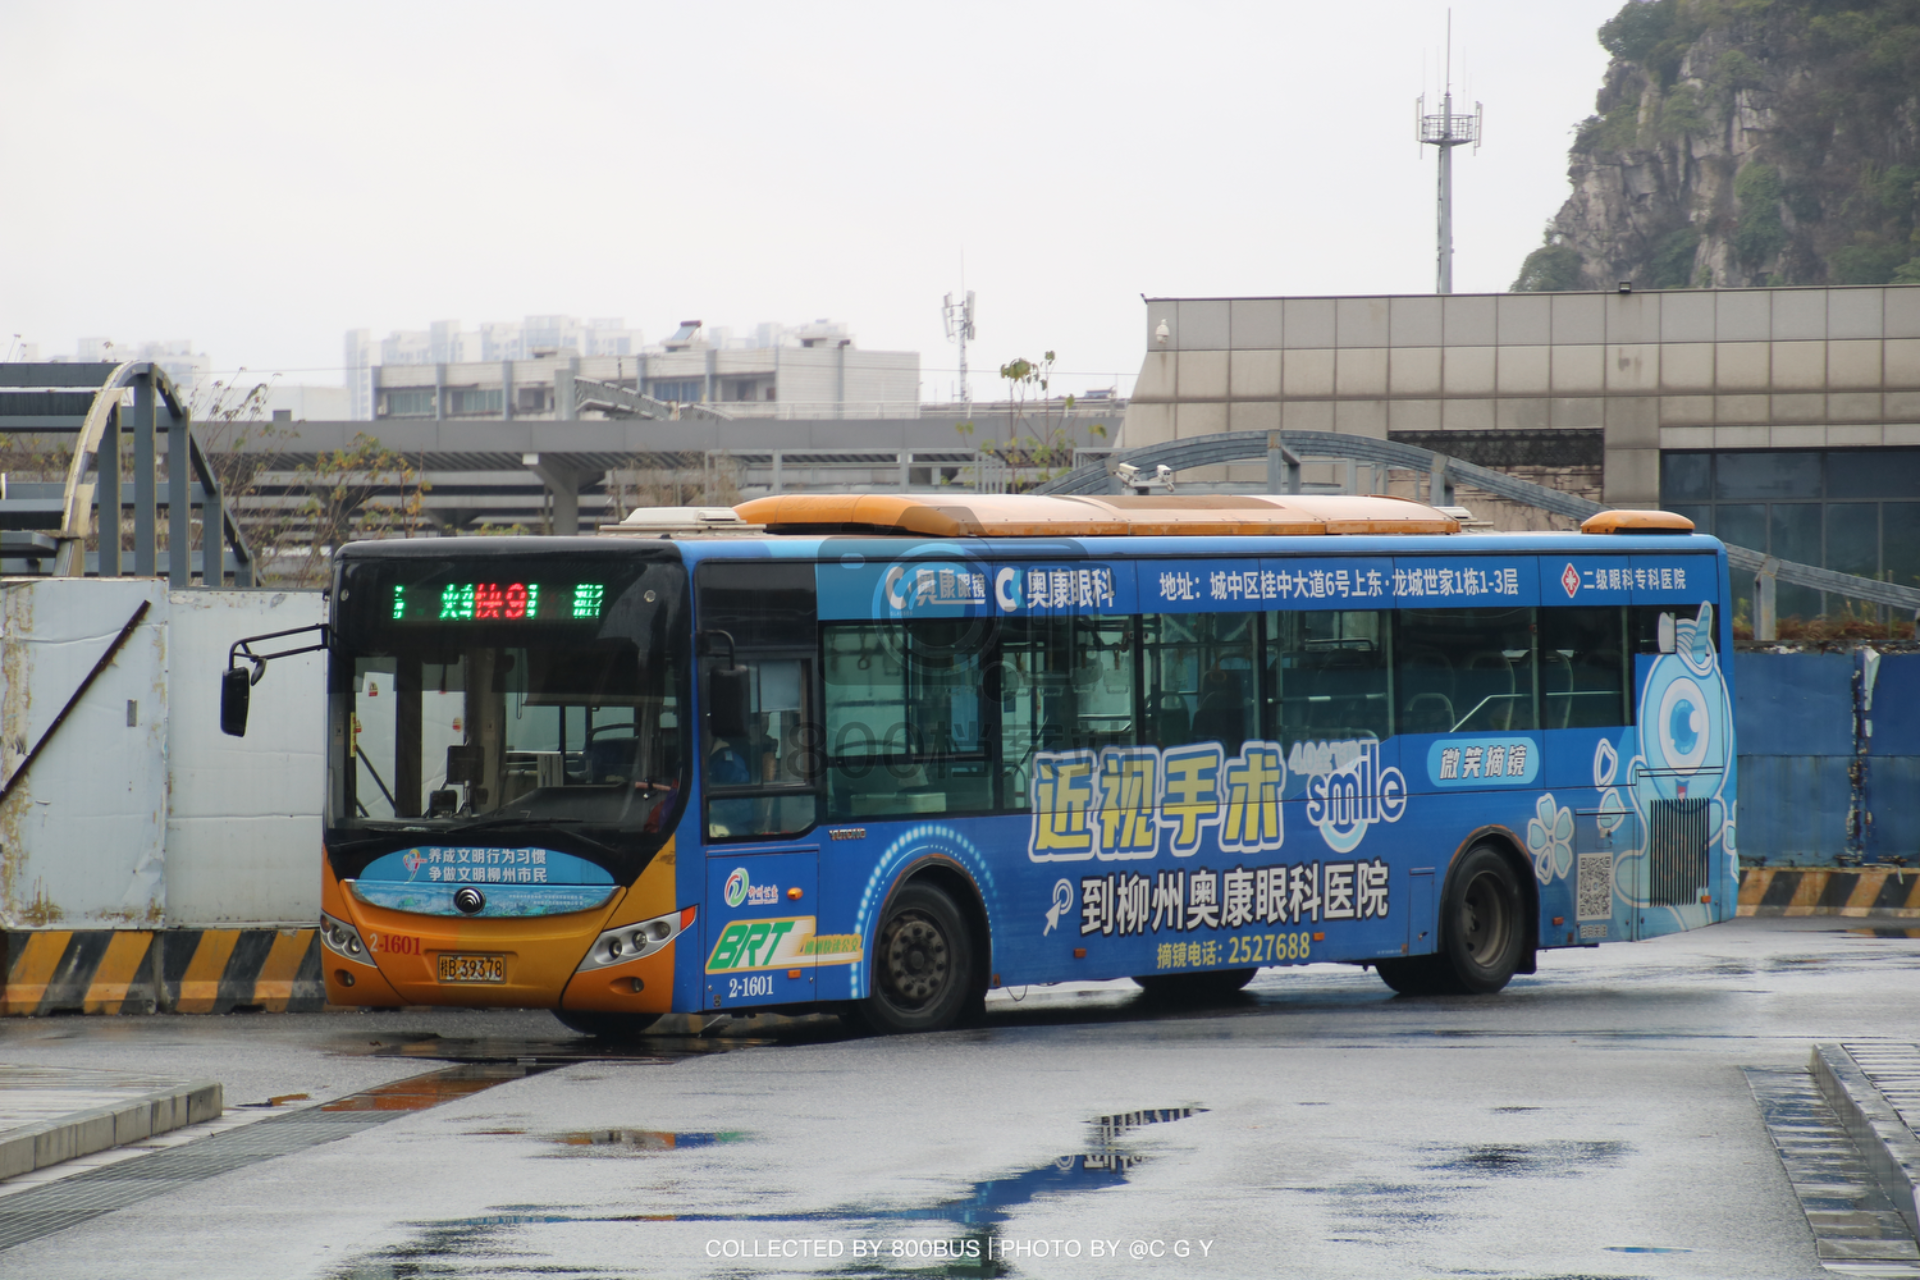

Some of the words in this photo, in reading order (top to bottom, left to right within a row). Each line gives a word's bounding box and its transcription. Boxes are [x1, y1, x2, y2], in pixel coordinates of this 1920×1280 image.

[1027, 567, 1115, 608] 奥康眼科
[1583, 567, 1687, 591] 二级眼科专科医院
[1440, 745, 1527, 779] 微笑摘镜
[1307, 739, 1407, 826] smile
[1030, 742, 1285, 861] 近视手术
[429, 849, 547, 864] 养成文明行为习惯
[429, 867, 548, 882] 争做文明柳州市民
[1081, 860, 1389, 935] 到柳州奥康眼科医院
[369, 932, 422, 956] 2-1601
[707, 921, 795, 969] BRT
[729, 975, 774, 998] 2-1601
